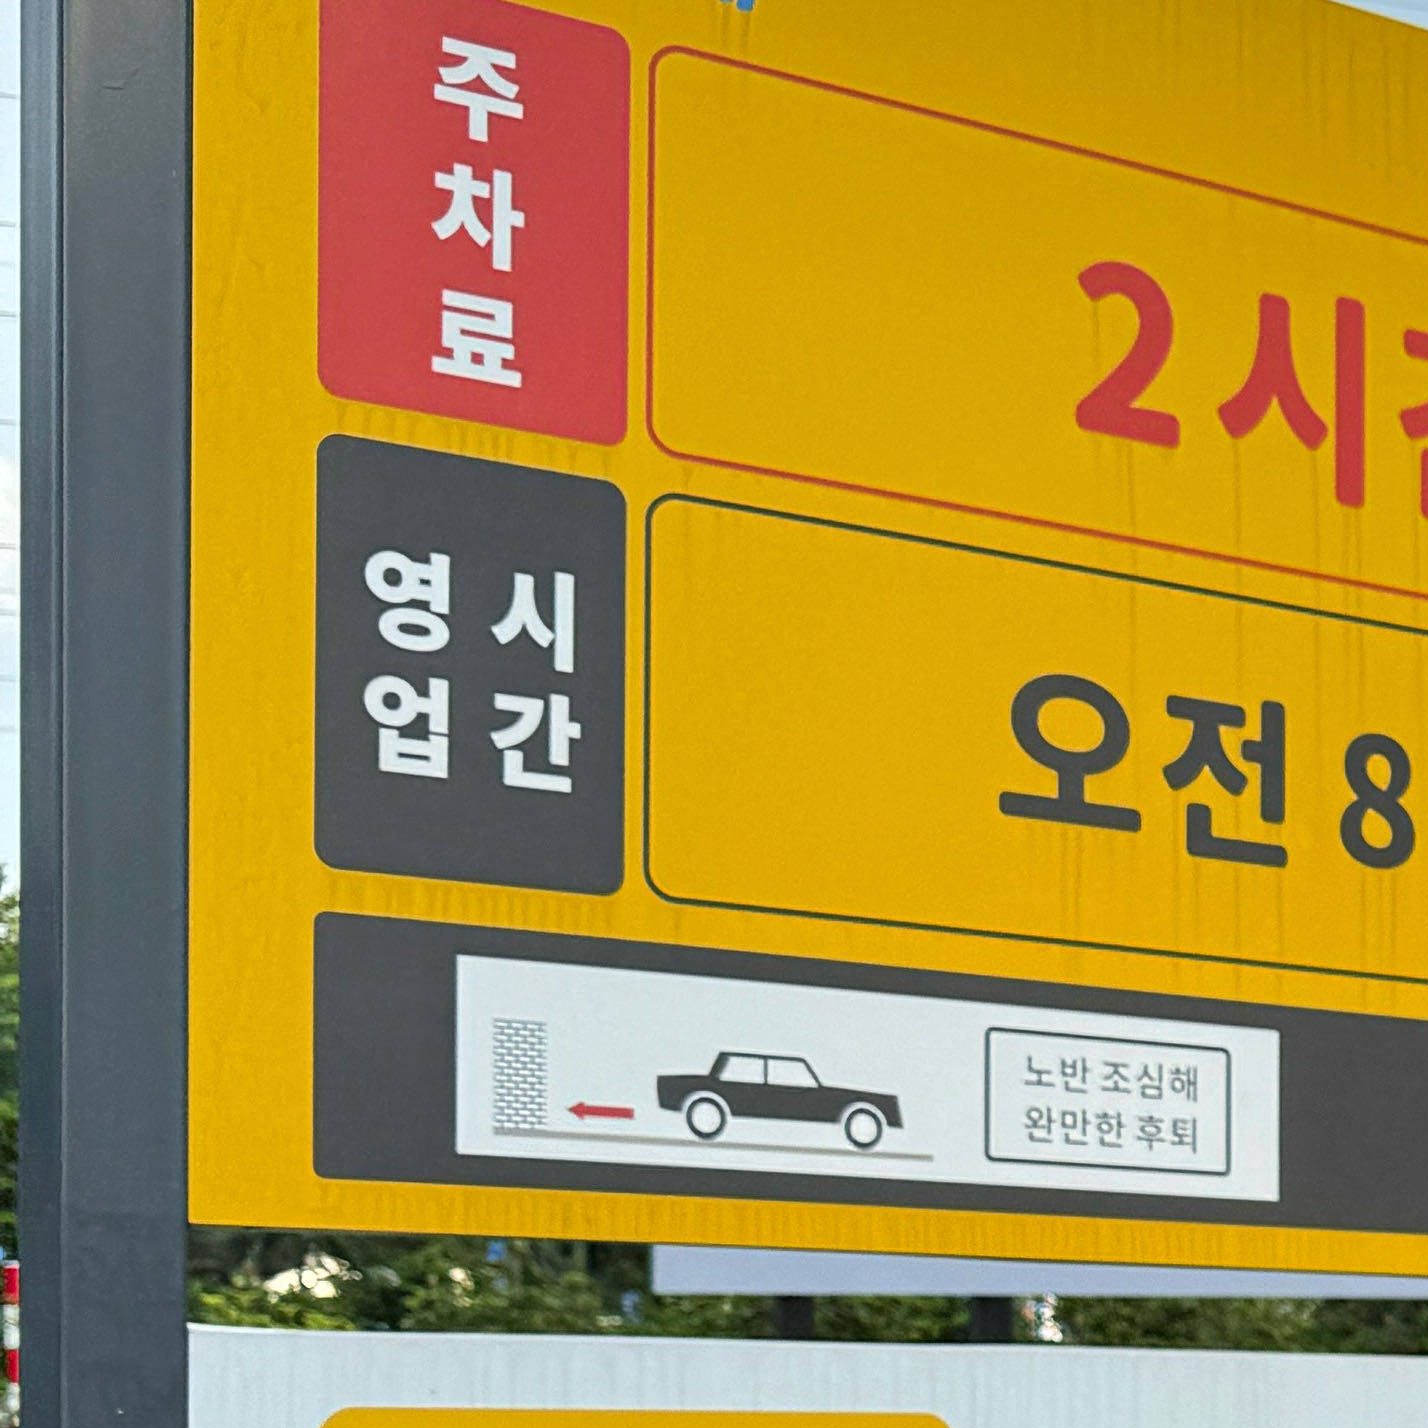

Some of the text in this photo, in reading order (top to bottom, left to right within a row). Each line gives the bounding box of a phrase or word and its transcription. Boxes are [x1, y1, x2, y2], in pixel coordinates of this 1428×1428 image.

[432, 37, 524, 387] 주차료
[999, 674, 1288, 868] 오전
[1024, 1056, 1197, 1102] 노반 조심해
[1025, 1107, 1196, 1154] 완만한 후퇴
